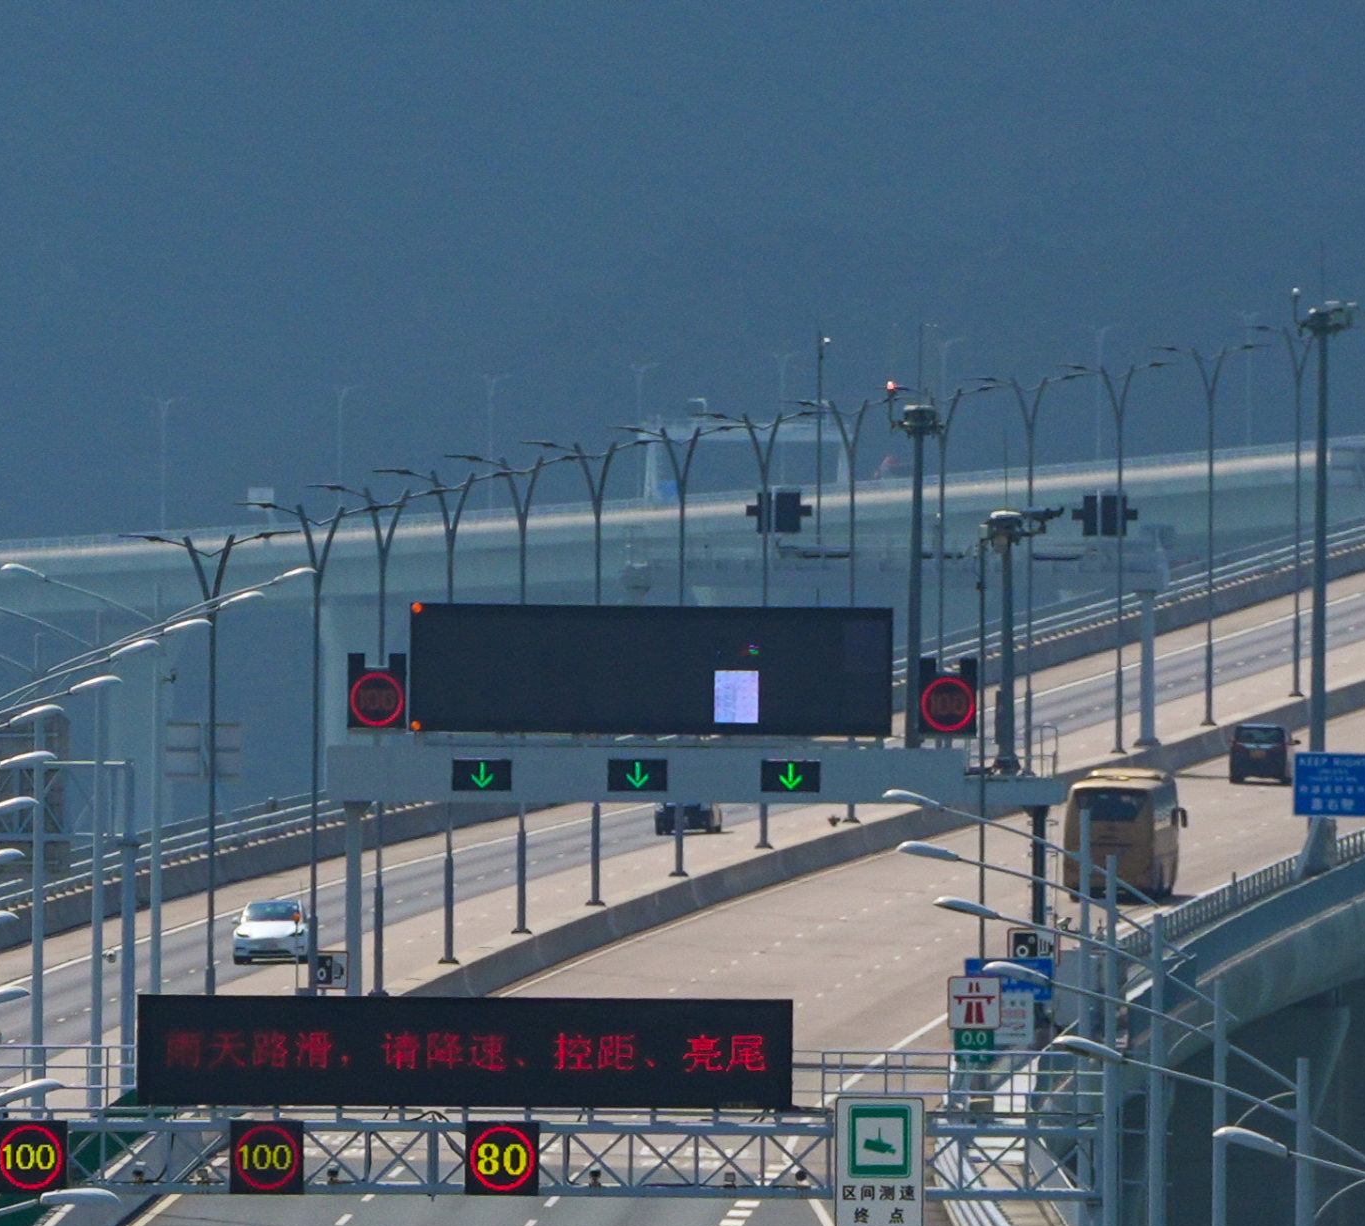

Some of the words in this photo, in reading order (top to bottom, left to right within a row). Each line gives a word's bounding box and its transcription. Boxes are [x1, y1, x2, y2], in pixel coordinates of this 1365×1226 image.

[961, 1031, 987, 1046] 0.0
[3, 1144, 55, 1170] 100
[239, 1144, 292, 1170] 100
[476, 1143, 527, 1176] 80
[842, 1185, 916, 1201] 区间测速
